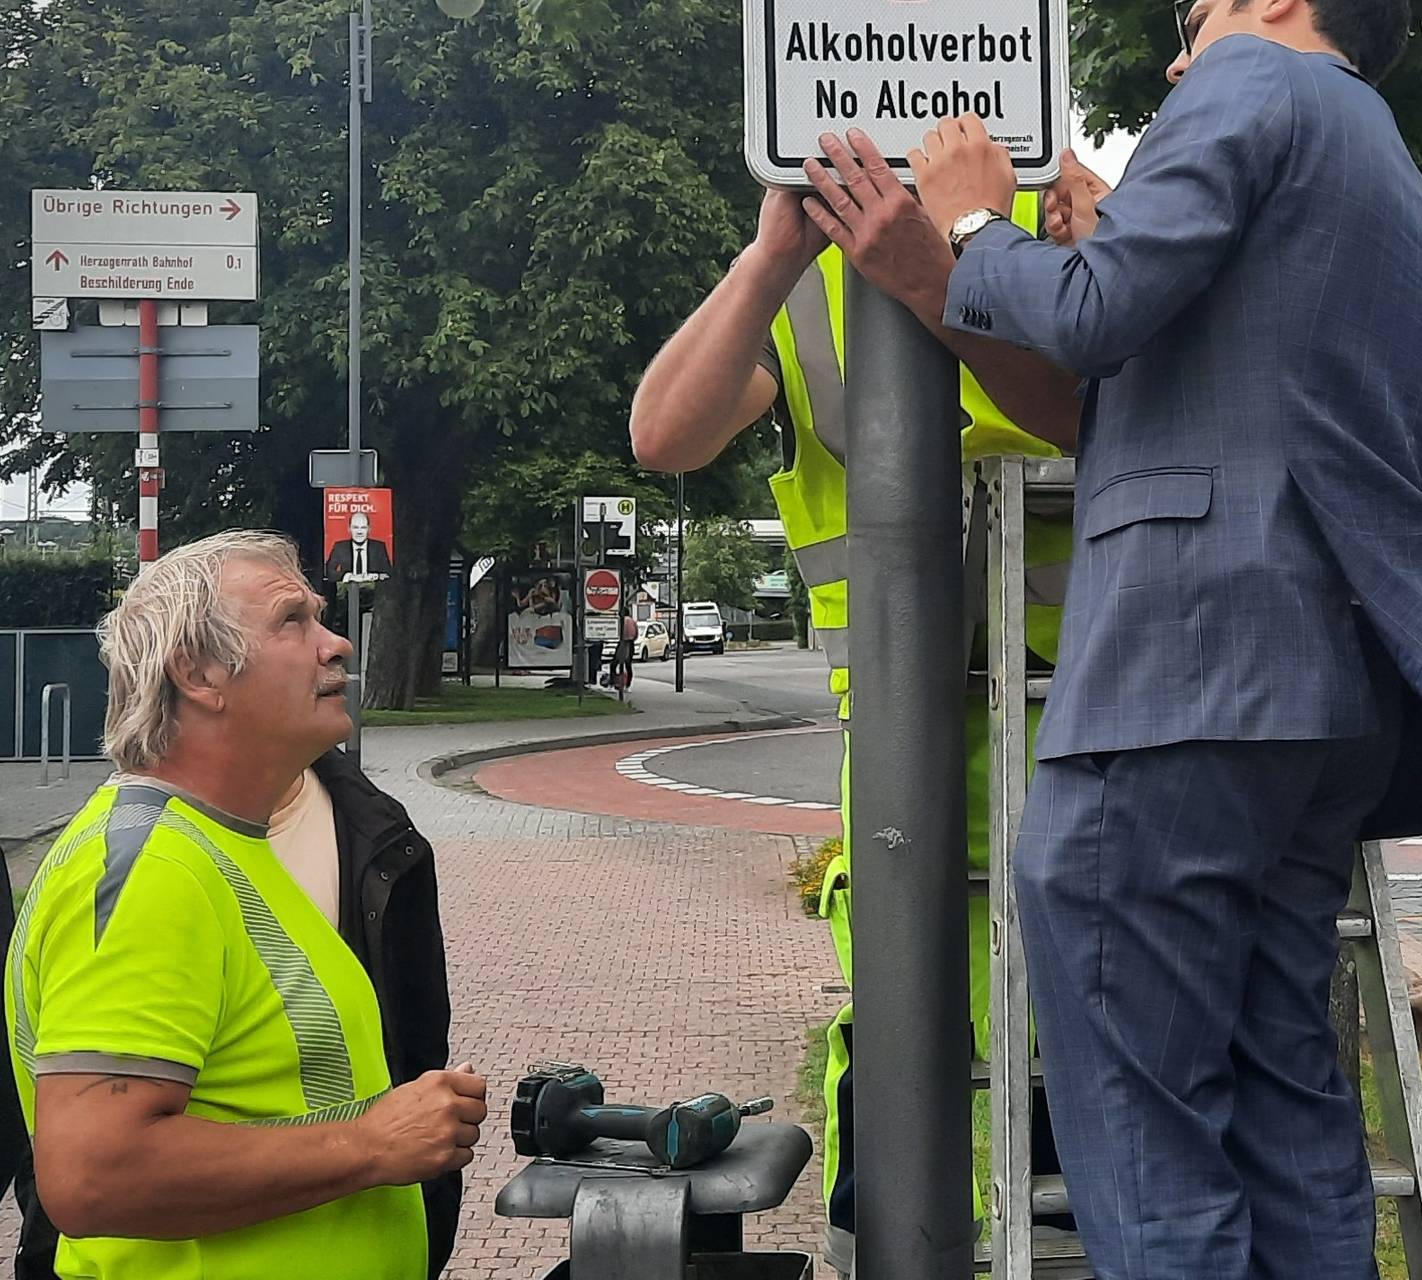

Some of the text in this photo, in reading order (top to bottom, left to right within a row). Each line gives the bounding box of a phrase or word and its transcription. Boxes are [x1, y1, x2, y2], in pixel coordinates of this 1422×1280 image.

[786, 22, 1032, 62] Alkoholverbot
[816, 80, 1005, 119] No Alcohol
[43, 196, 212, 218] Übrige Richtungen
[80, 255, 148, 269] Herzogenrath
[152, 256, 193, 268] Bahnhof
[80, 276, 194, 292] Beschilderung Ende
[328, 493, 369, 502] RESPEKT
[328, 503, 348, 512] FÜR
[621, 503, 630, 512] H
